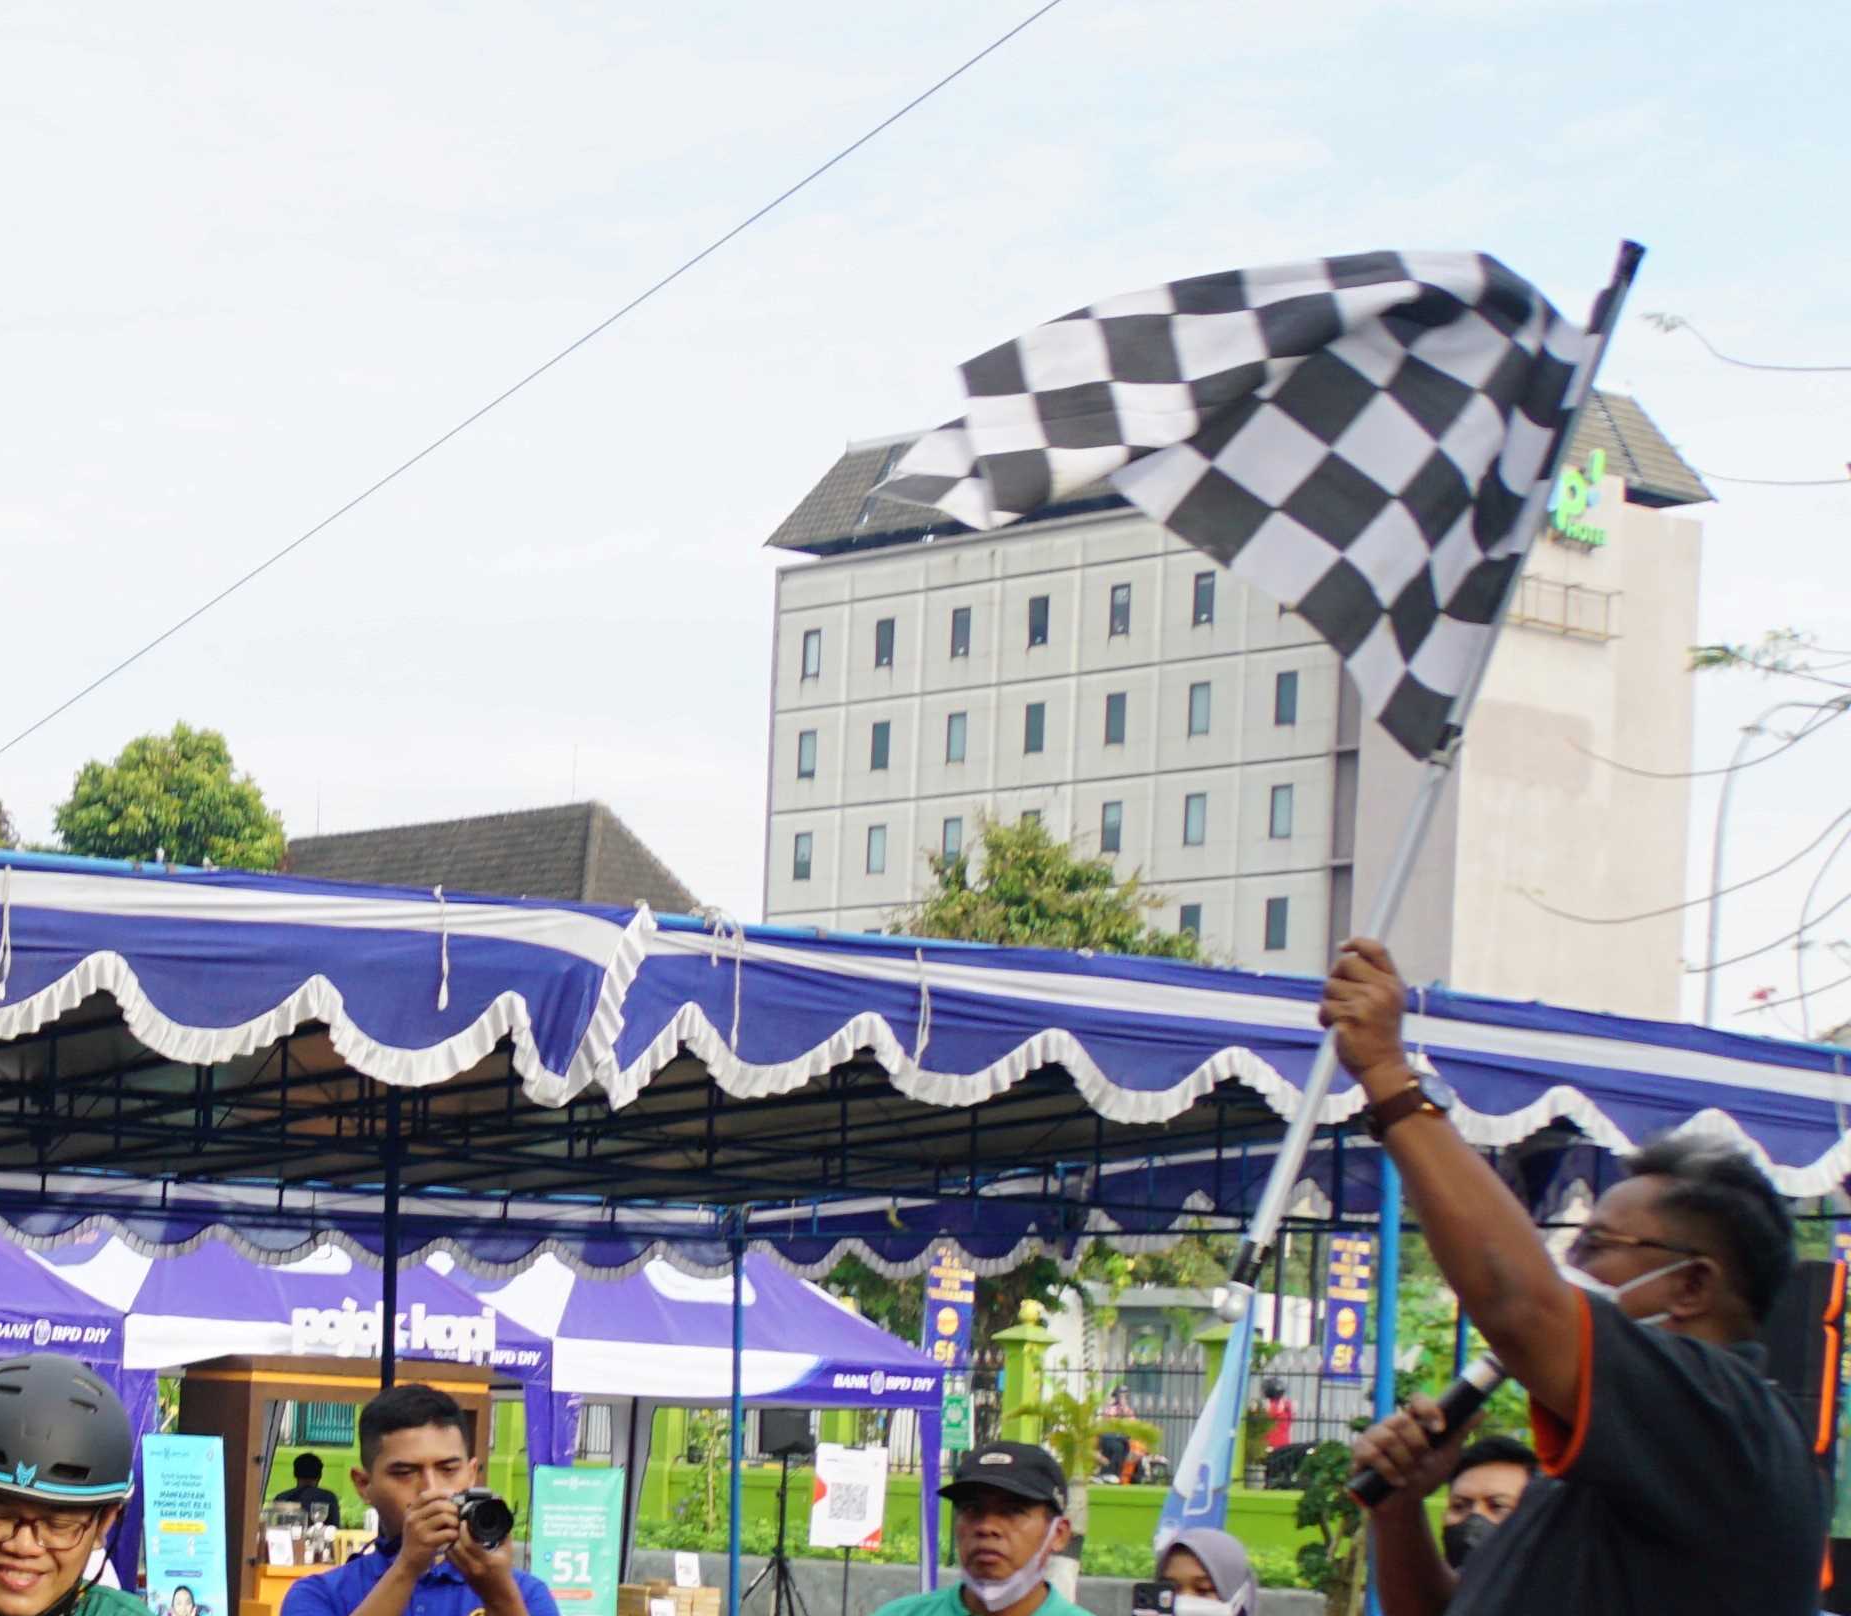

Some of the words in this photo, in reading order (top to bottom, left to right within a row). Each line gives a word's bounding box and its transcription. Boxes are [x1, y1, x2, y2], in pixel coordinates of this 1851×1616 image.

[51, 1325, 83, 1342] BPD
[83, 1327, 112, 1344] DIY
[291, 1297, 409, 1358] pojok
[411, 1303, 496, 1363] kopi
[833, 1373, 869, 1389] BANK
[886, 1375, 911, 1391] BPD
[911, 1377, 936, 1392] DIY
[552, 1551, 592, 1583] 51
